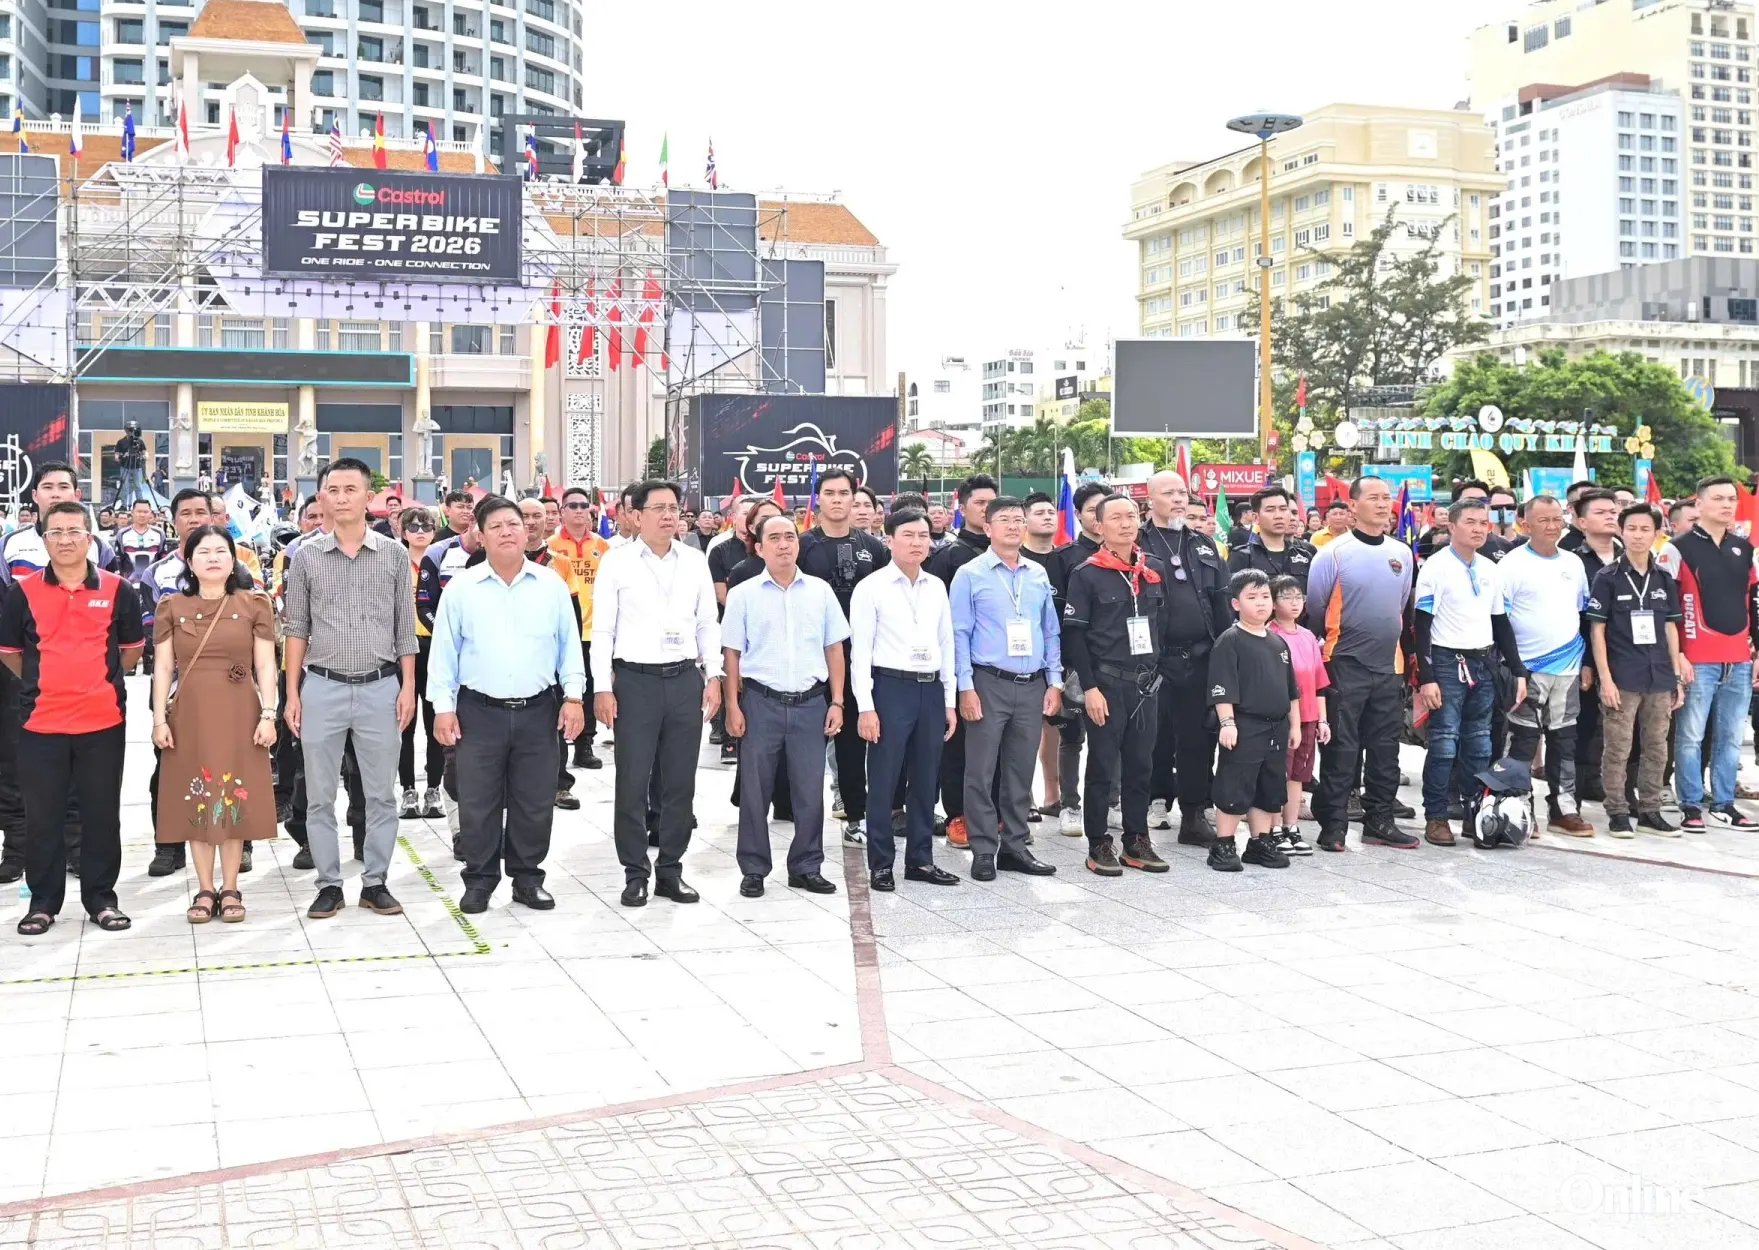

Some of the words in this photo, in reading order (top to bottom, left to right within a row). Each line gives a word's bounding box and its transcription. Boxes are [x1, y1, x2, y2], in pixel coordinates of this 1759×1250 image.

[378, 187, 444, 205] Castrol
[289, 210, 500, 234] SUPERBIKE
[311, 233, 406, 251] FEST
[410, 235, 481, 255] 2026
[301, 257, 329, 265] ONE
[333, 258, 365, 266] RIDE
[405, 260, 491, 270] CONNECTION
[1220, 471, 1263, 483] MIXUE
[1683, 594, 1697, 639] DUCATI
